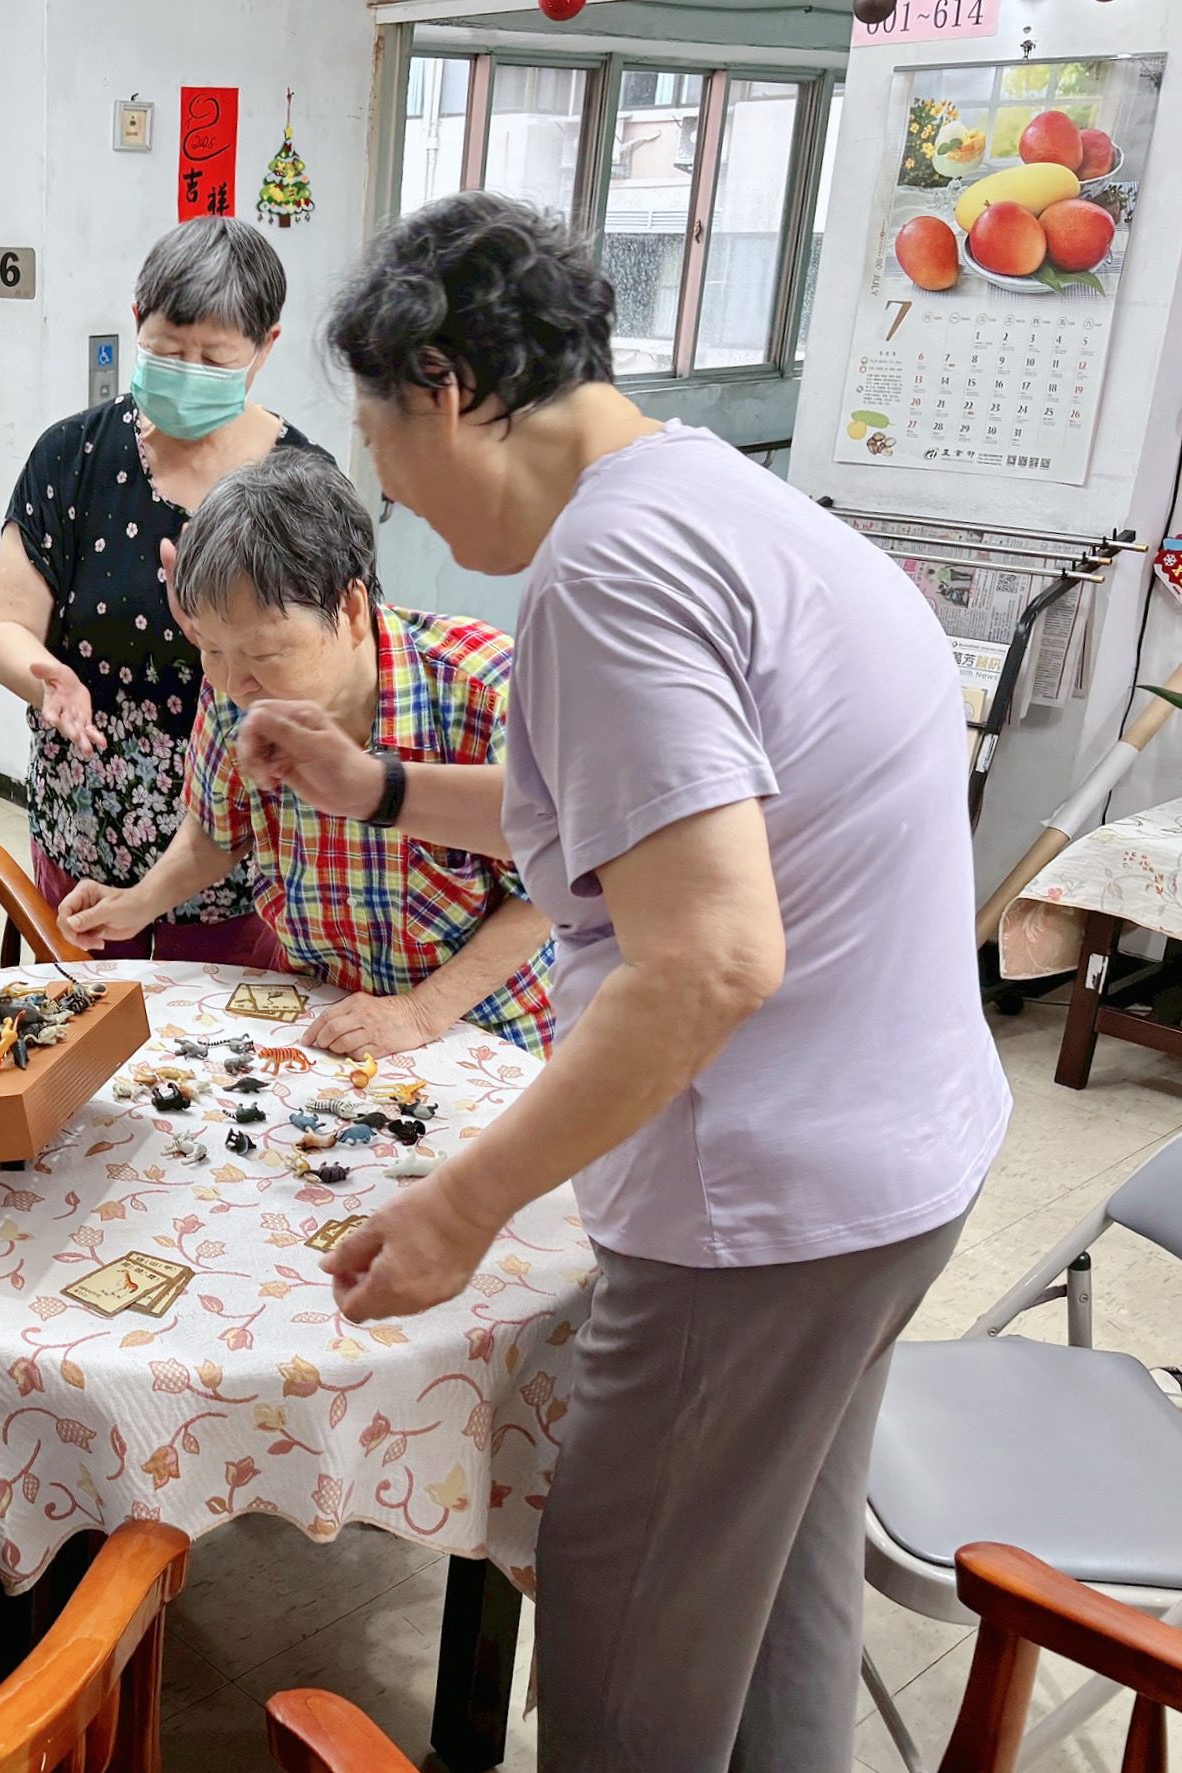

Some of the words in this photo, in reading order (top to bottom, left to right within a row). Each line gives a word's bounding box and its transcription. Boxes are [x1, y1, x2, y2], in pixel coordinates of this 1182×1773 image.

[866, 0, 984, 35] 01~614
[0, 252, 20, 287] 6
[885, 300, 913, 341] 7
[1026, 358, 1035, 367] 10
[1052, 359, 1059, 368] 11
[1078, 361, 1087, 370] 12
[914, 375, 923, 384] 13
[941, 376, 950, 385] 14
[968, 378, 976, 387] 15
[995, 380, 1004, 389] 16
[1021, 381, 1031, 390] 17
[1048, 383, 1058, 392] 18
[1074, 385, 1083, 394] 19
[910, 398, 921, 406] 20
[937, 399, 945, 408] 21
[964, 401, 974, 410] 22
[990, 403, 1000, 412] 23
[1017, 405, 1028, 414] 24
[1044, 407, 1054, 416] 25
[1070, 409, 1080, 418] 26
[907, 420, 918, 429] 27
[933, 422, 944, 431] 28
[959, 424, 970, 433] 29
[987, 426, 997, 435] 30
[1014, 428, 1022, 437] 31
